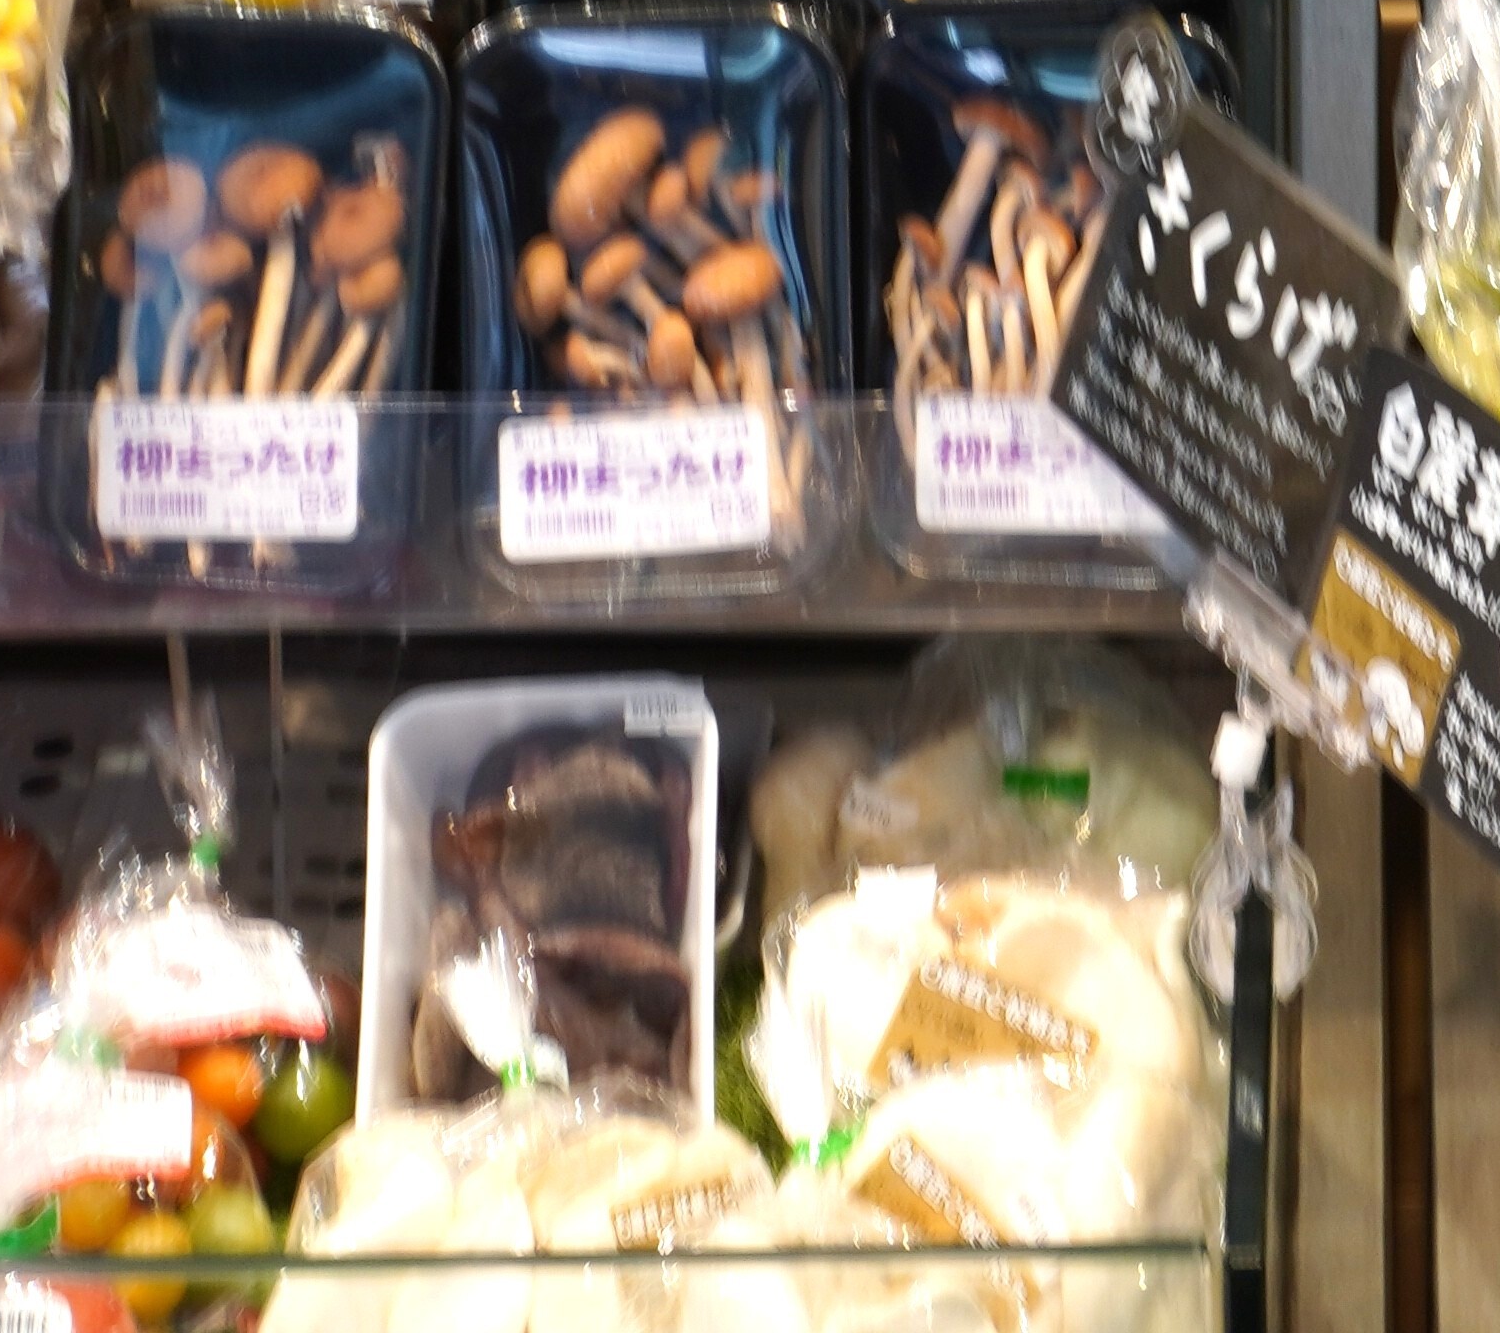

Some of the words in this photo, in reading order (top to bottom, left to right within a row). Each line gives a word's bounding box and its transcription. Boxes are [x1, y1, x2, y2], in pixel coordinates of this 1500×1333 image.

[114, 433, 344, 480] 柳まつたけ
[517, 448, 747, 504] 柳まつたけ
